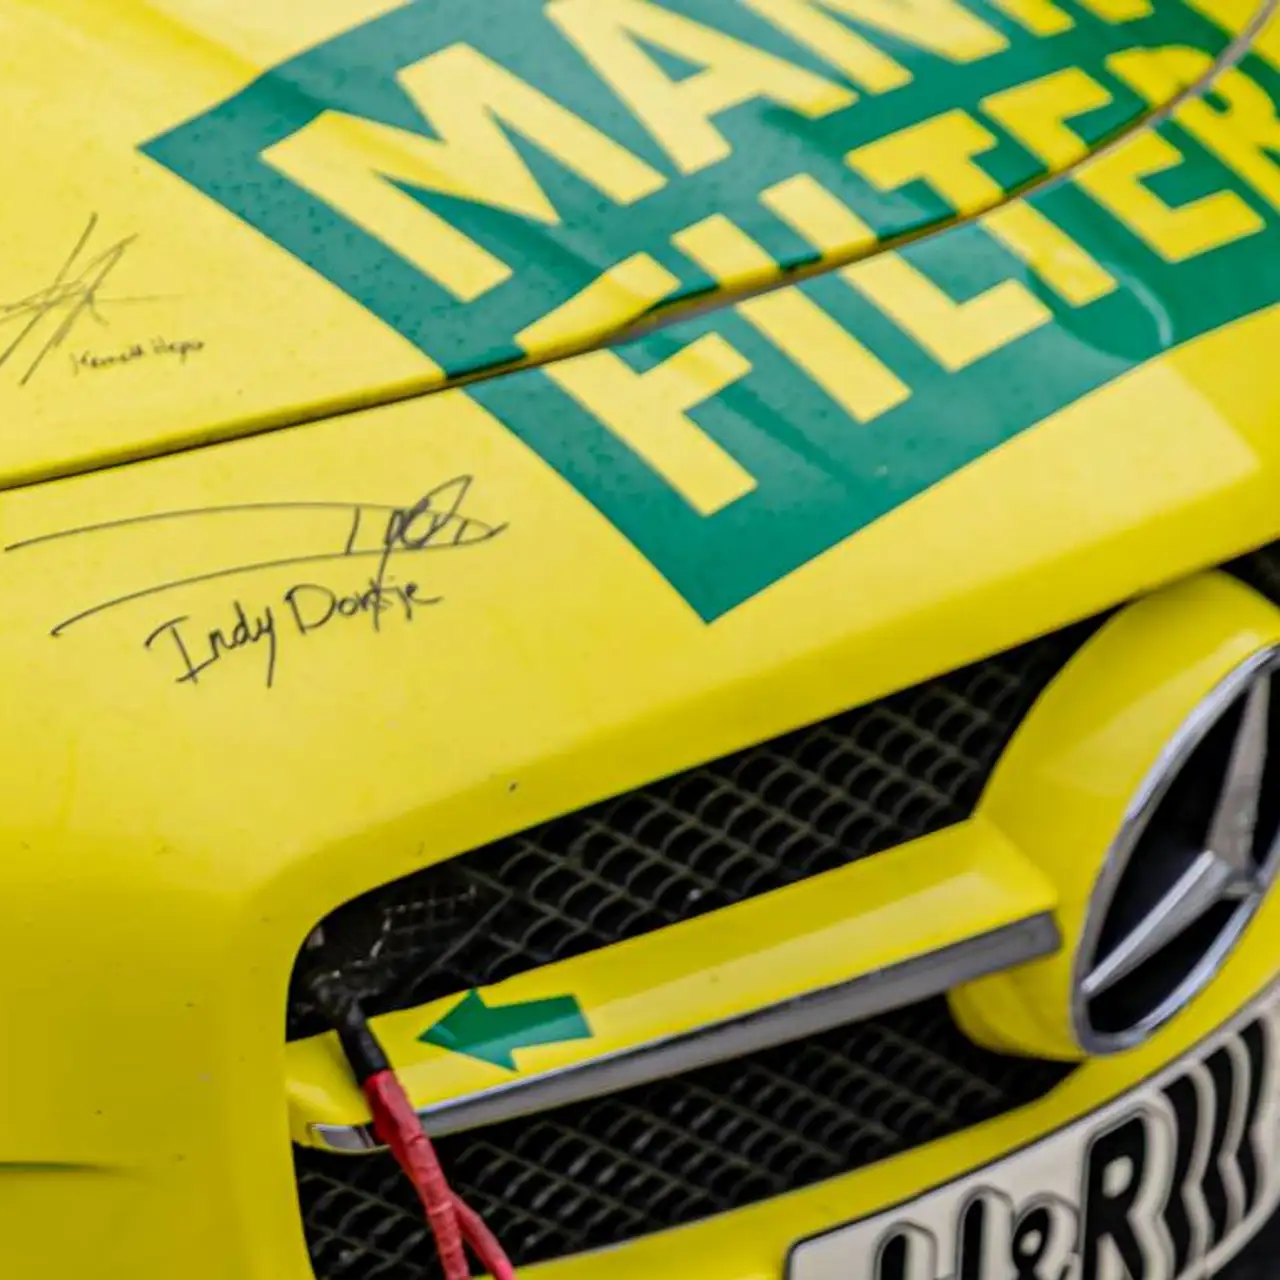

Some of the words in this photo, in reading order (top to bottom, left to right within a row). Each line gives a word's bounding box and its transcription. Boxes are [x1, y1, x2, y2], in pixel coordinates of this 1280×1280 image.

[260, 0, 1154, 303] MAN
[515, 44, 1280, 517] FILTER
[143, 600, 276, 688] Indy
